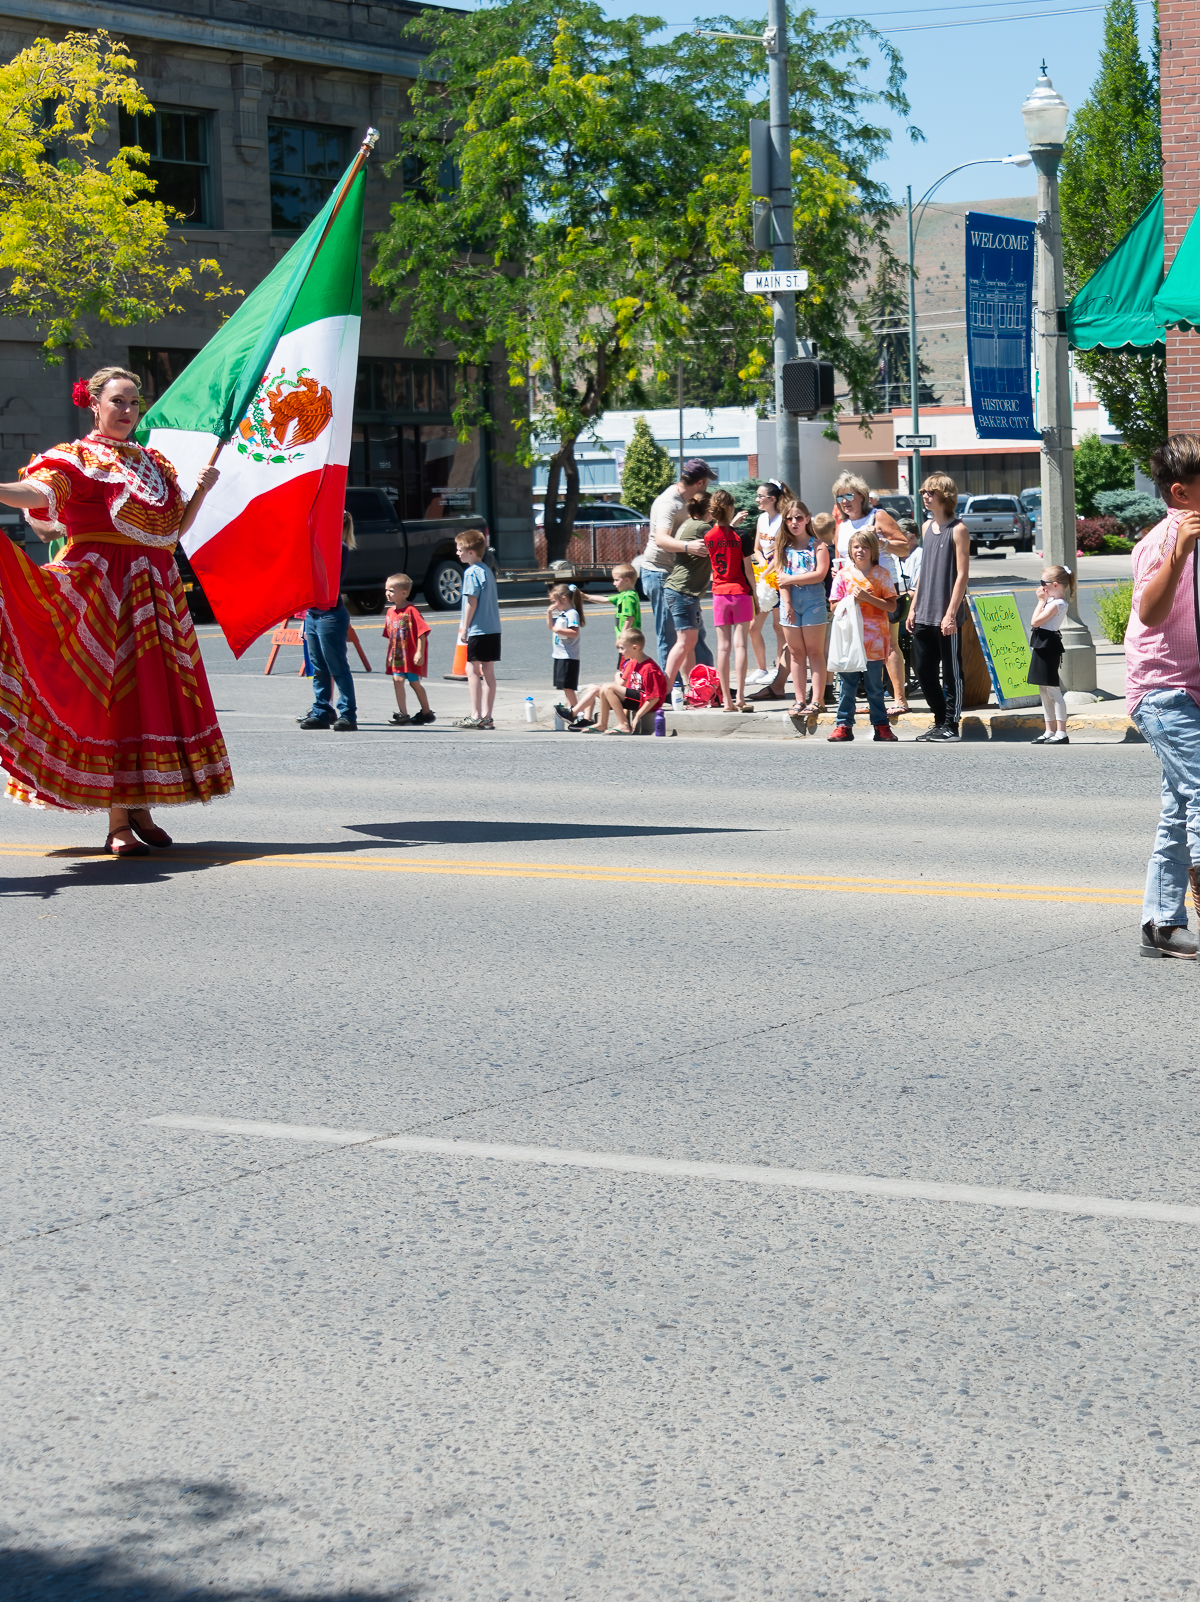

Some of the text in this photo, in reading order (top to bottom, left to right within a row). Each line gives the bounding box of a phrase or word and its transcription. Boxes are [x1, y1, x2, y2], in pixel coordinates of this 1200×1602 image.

[970, 231, 1029, 250] WELCOME
[756, 275, 800, 288] MAIN ST.
[980, 398, 1020, 412] HISTORIC
[977, 414, 1030, 429] BAKER CITY
[716, 553, 728, 575] 5
[977, 602, 1016, 622] Yard Sale
